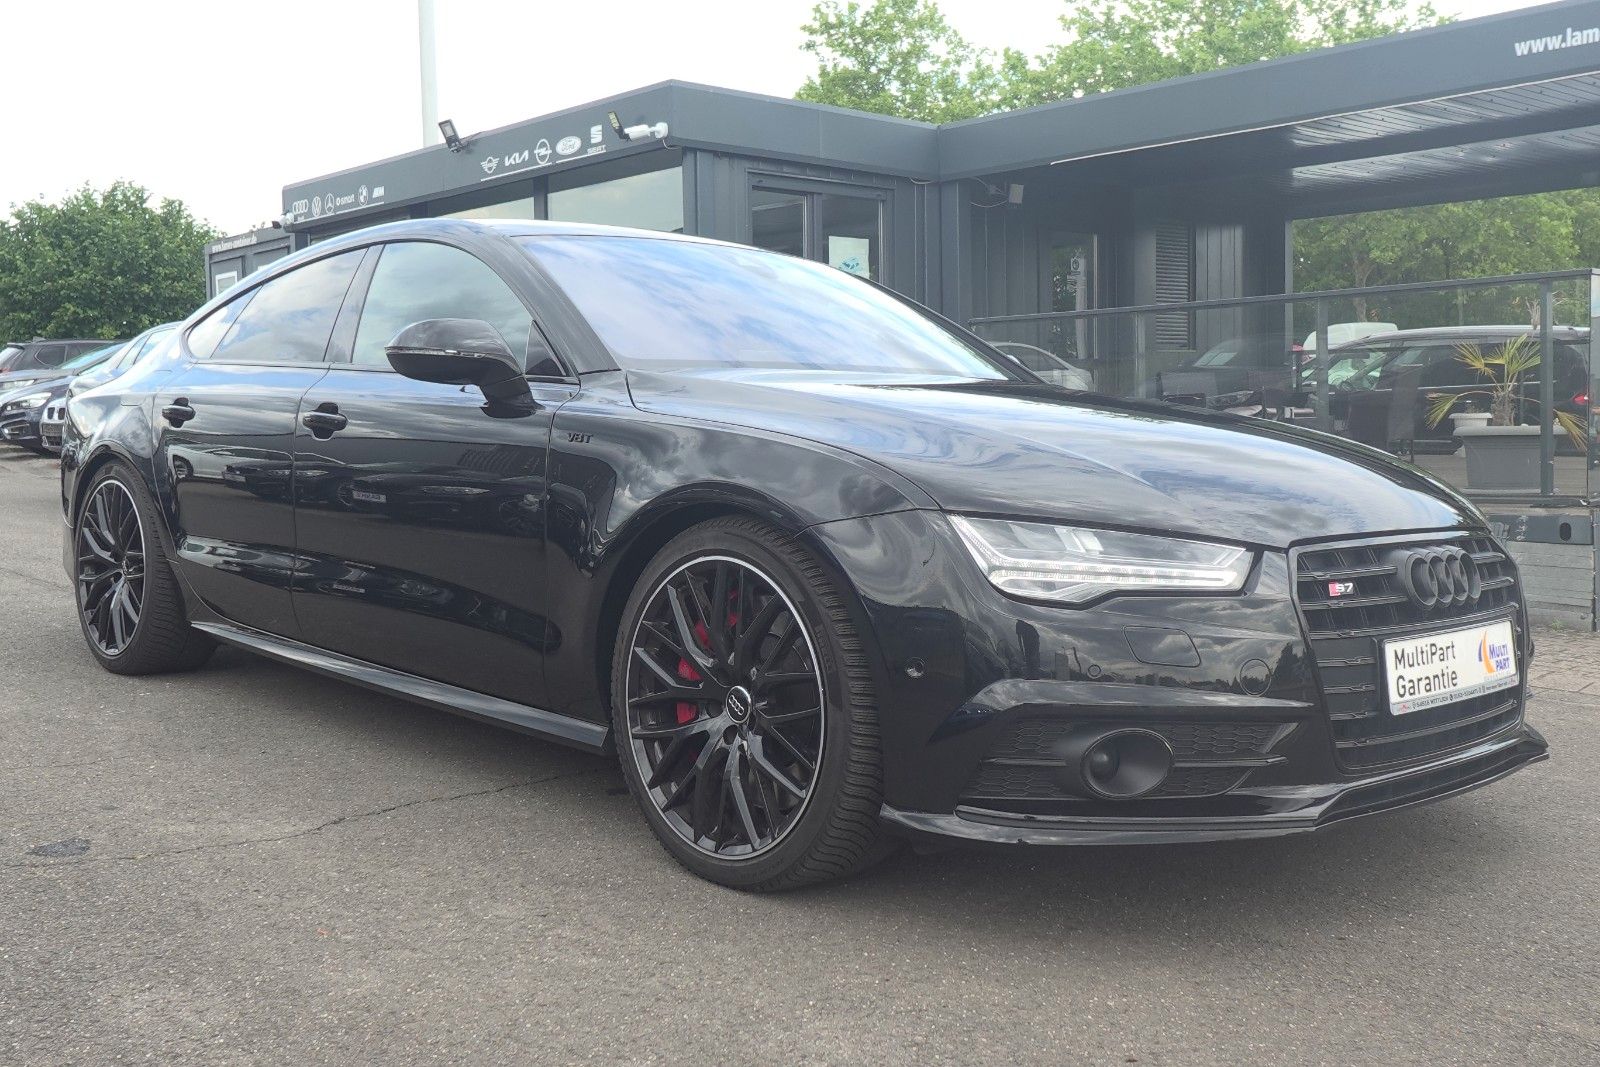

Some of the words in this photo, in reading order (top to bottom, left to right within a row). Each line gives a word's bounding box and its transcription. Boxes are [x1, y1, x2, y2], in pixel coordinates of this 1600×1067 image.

[567, 432, 594, 444] V8T
[1335, 582, 1354, 593] S7
[1394, 640, 1456, 670] MultiPart
[1488, 643, 1508, 659] MULTI
[1495, 657, 1510, 671] PART
[1396, 666, 1458, 698] Garantie
